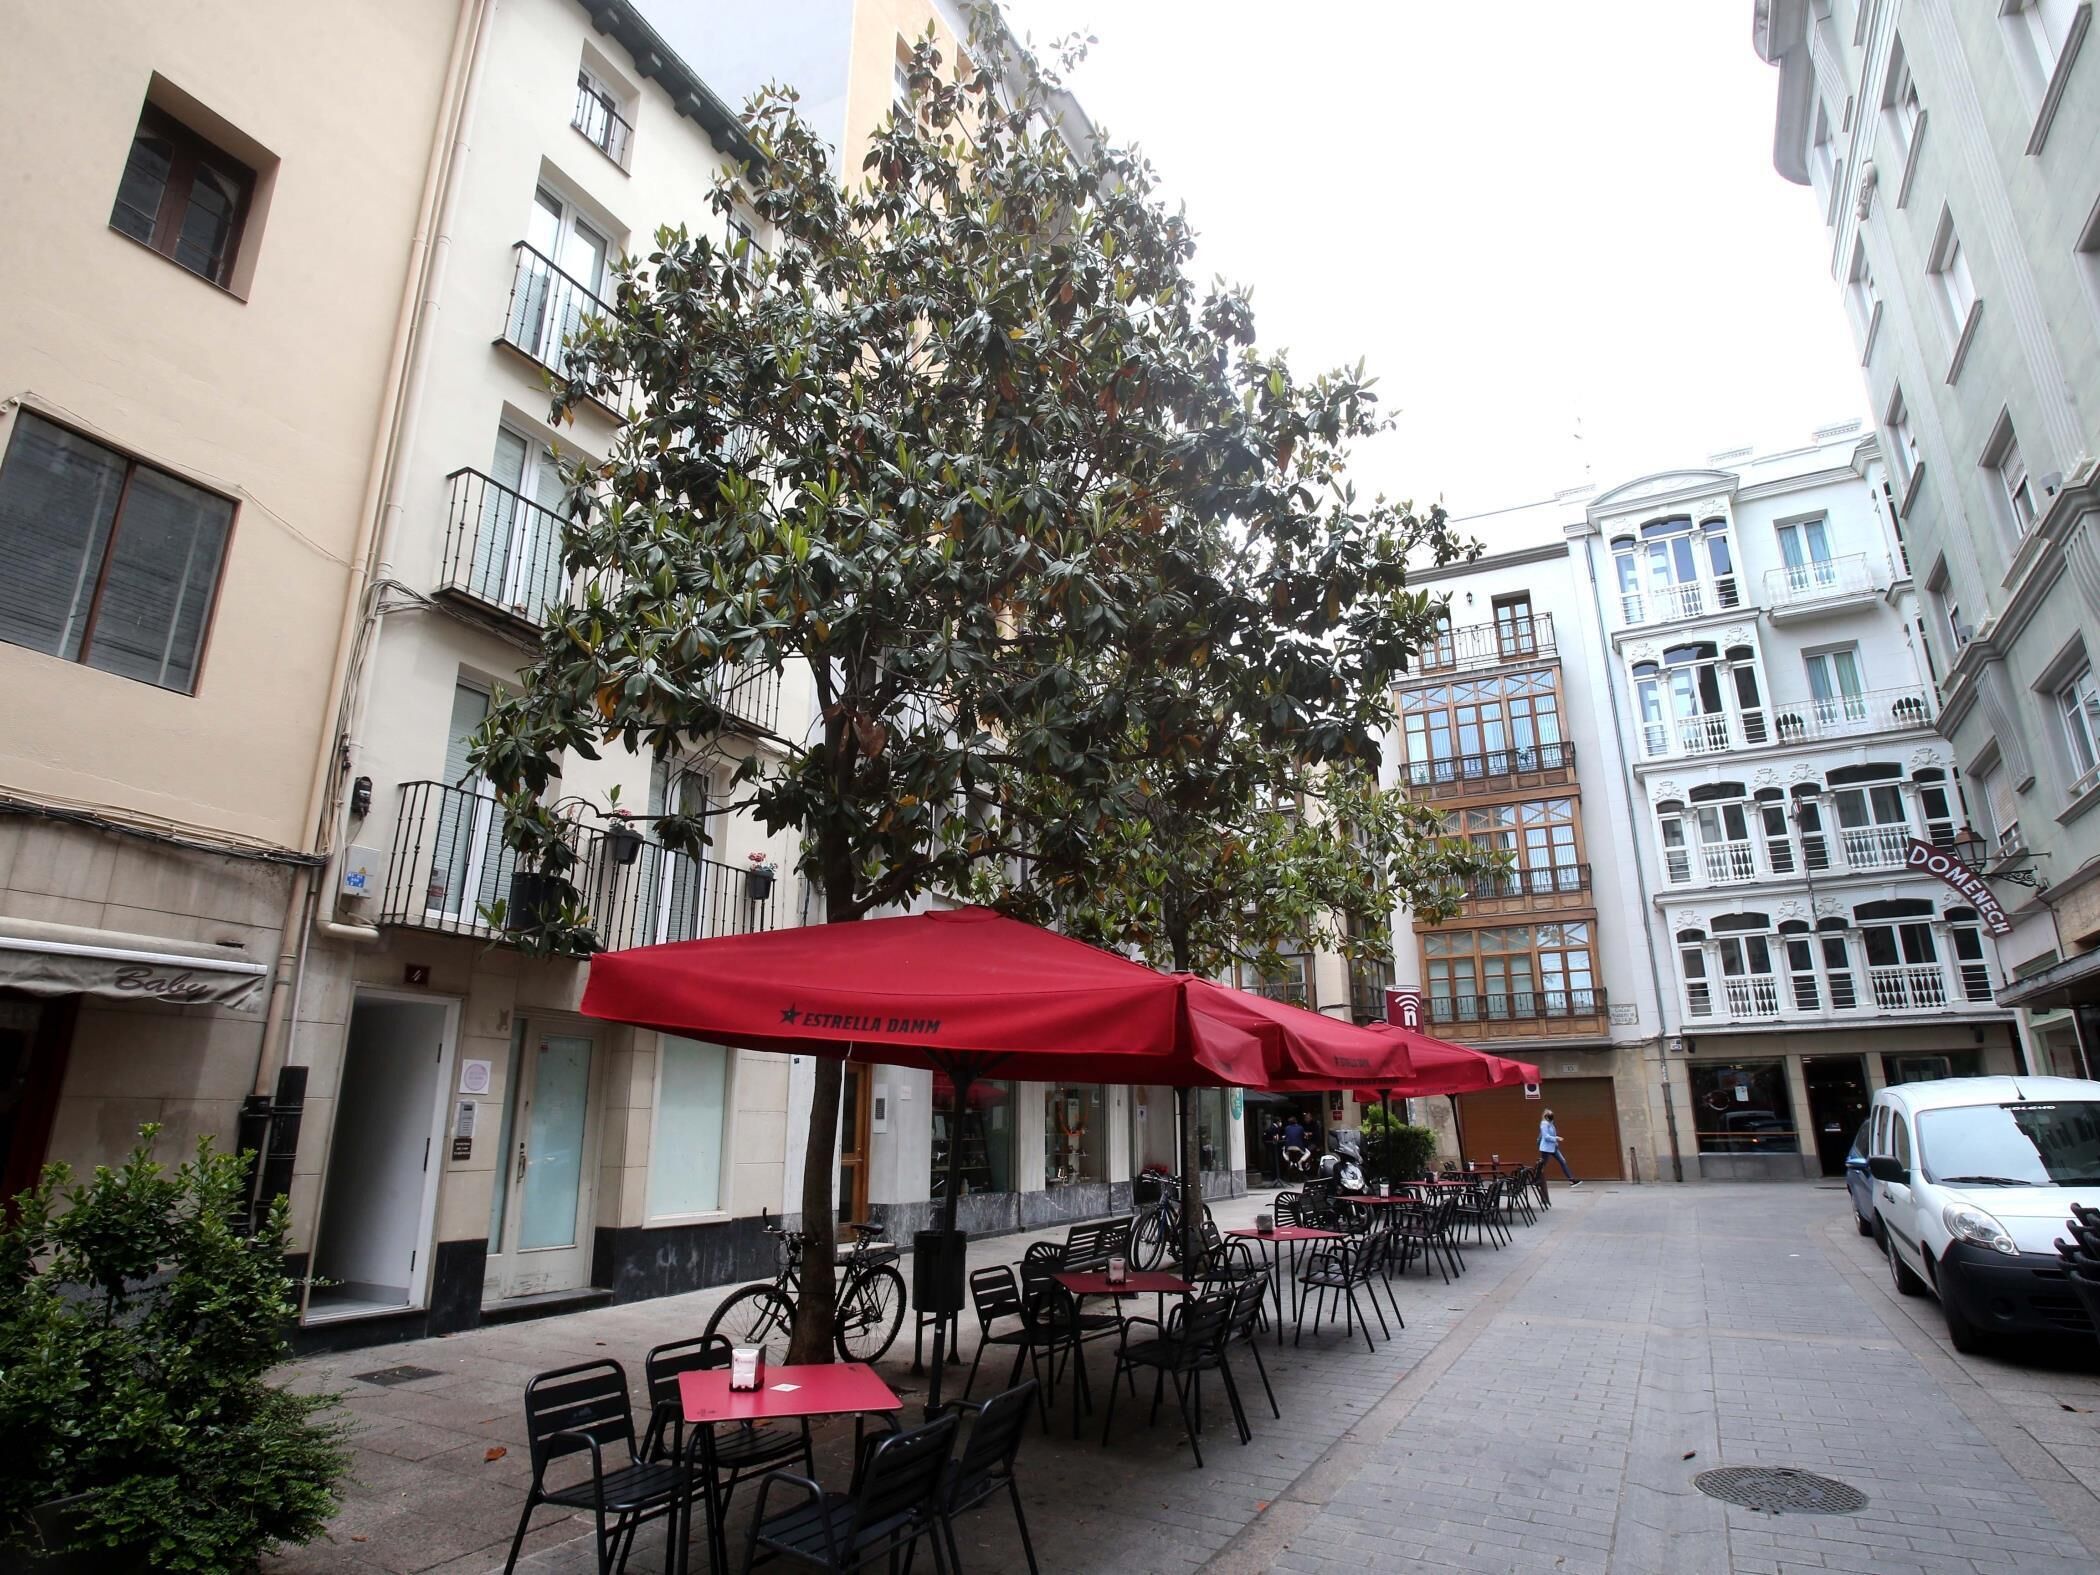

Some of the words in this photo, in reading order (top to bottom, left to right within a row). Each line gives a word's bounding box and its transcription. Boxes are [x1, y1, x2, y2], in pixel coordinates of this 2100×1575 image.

[1909, 845, 2010, 934] DOMENECH
[114, 966, 216, 1001] Baby
[801, 1012, 882, 1033] ESTRELLA
[886, 1017, 941, 1035] DAMM
